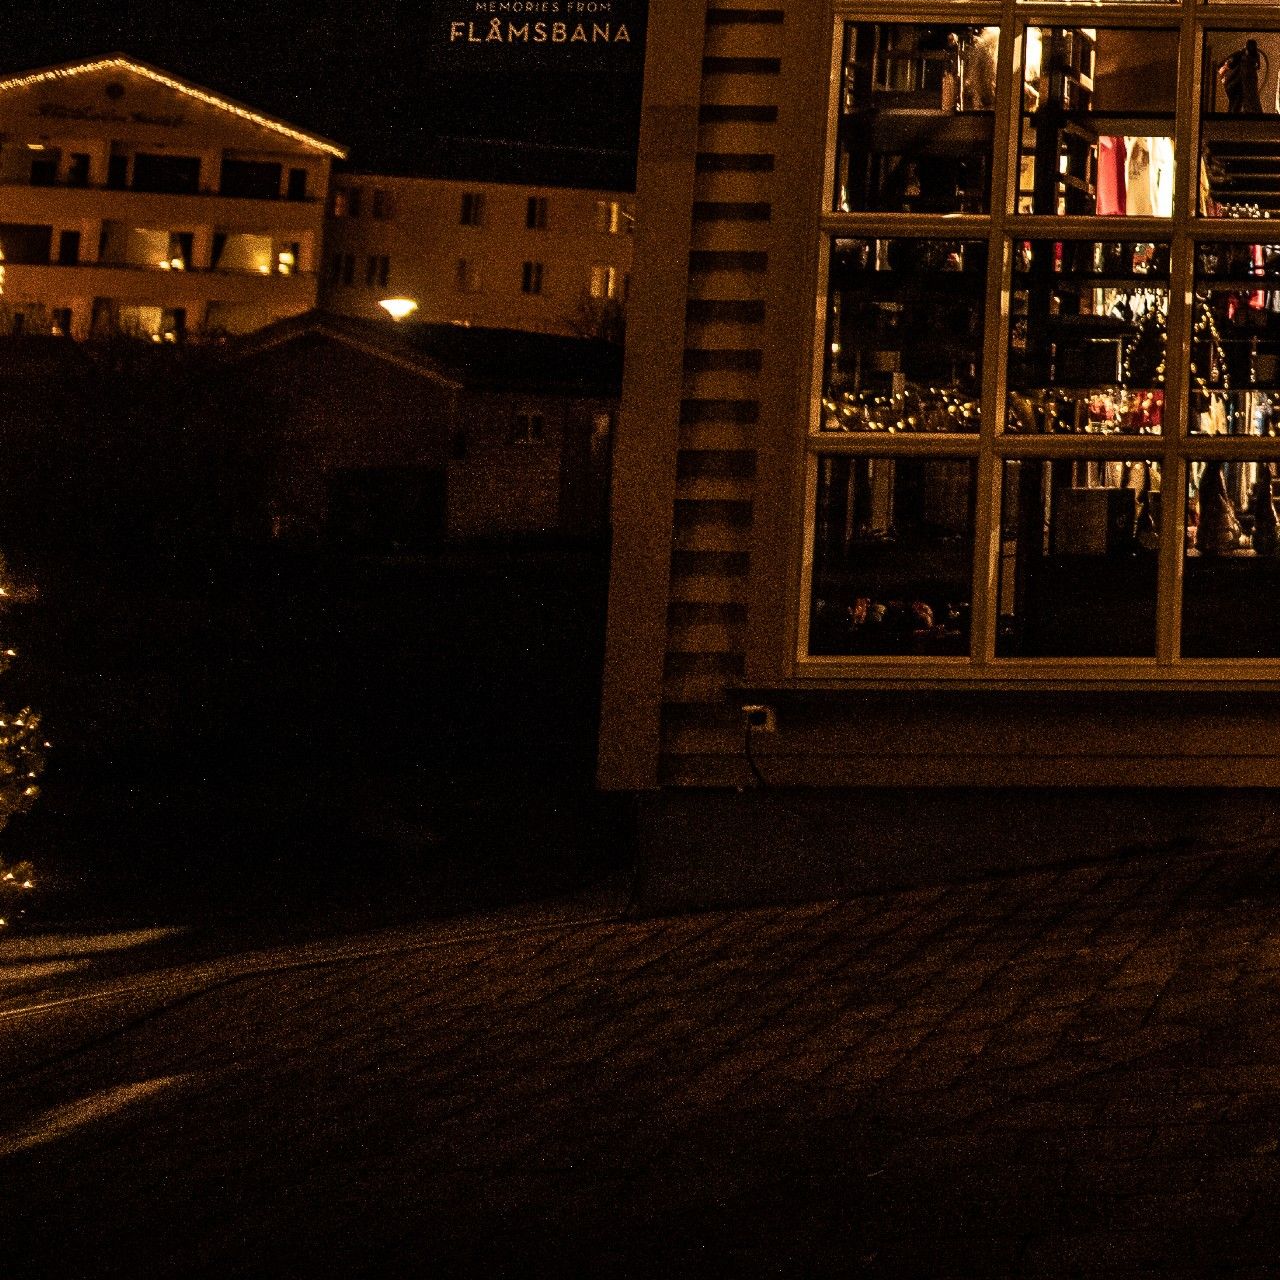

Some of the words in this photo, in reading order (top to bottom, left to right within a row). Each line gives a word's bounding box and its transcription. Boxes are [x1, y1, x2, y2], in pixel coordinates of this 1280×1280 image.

[475, 1, 560, 14] MEMORIES
[567, 1, 612, 13] FROM
[449, 17, 632, 44] FLÅMSBANA
